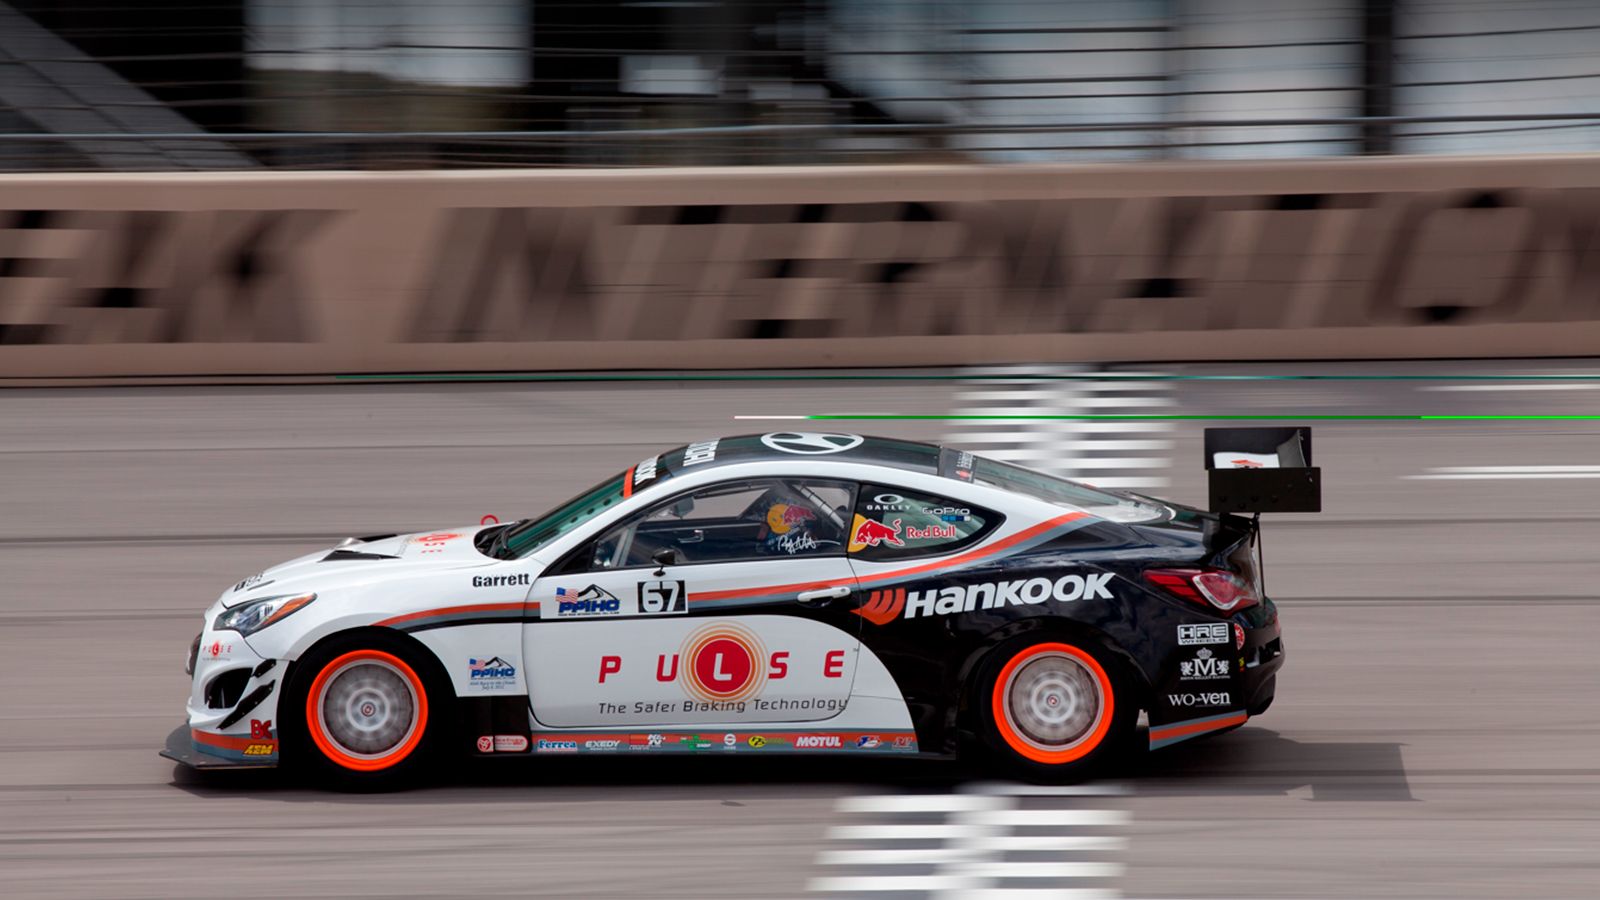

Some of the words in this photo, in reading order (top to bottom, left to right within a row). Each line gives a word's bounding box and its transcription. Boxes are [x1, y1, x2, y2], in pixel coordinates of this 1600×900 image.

[922, 506, 971, 515] GoPro
[906, 525, 931, 538] Red
[932, 524, 955, 537] Bull
[472, 573, 530, 588] Garrett
[642, 581, 680, 612] 67
[1180, 625, 1228, 639] HRE
[598, 650, 845, 684] PULSE
[1191, 658, 1218, 677] M
[598, 702, 627, 714] The
[634, 701, 676, 713] Safer
[683, 699, 746, 713] Braking
[753, 697, 848, 711] Technology
[538, 739, 577, 749] Ferrea
[585, 739, 621, 748] EXEDY
[796, 735, 842, 747] MOTUL
